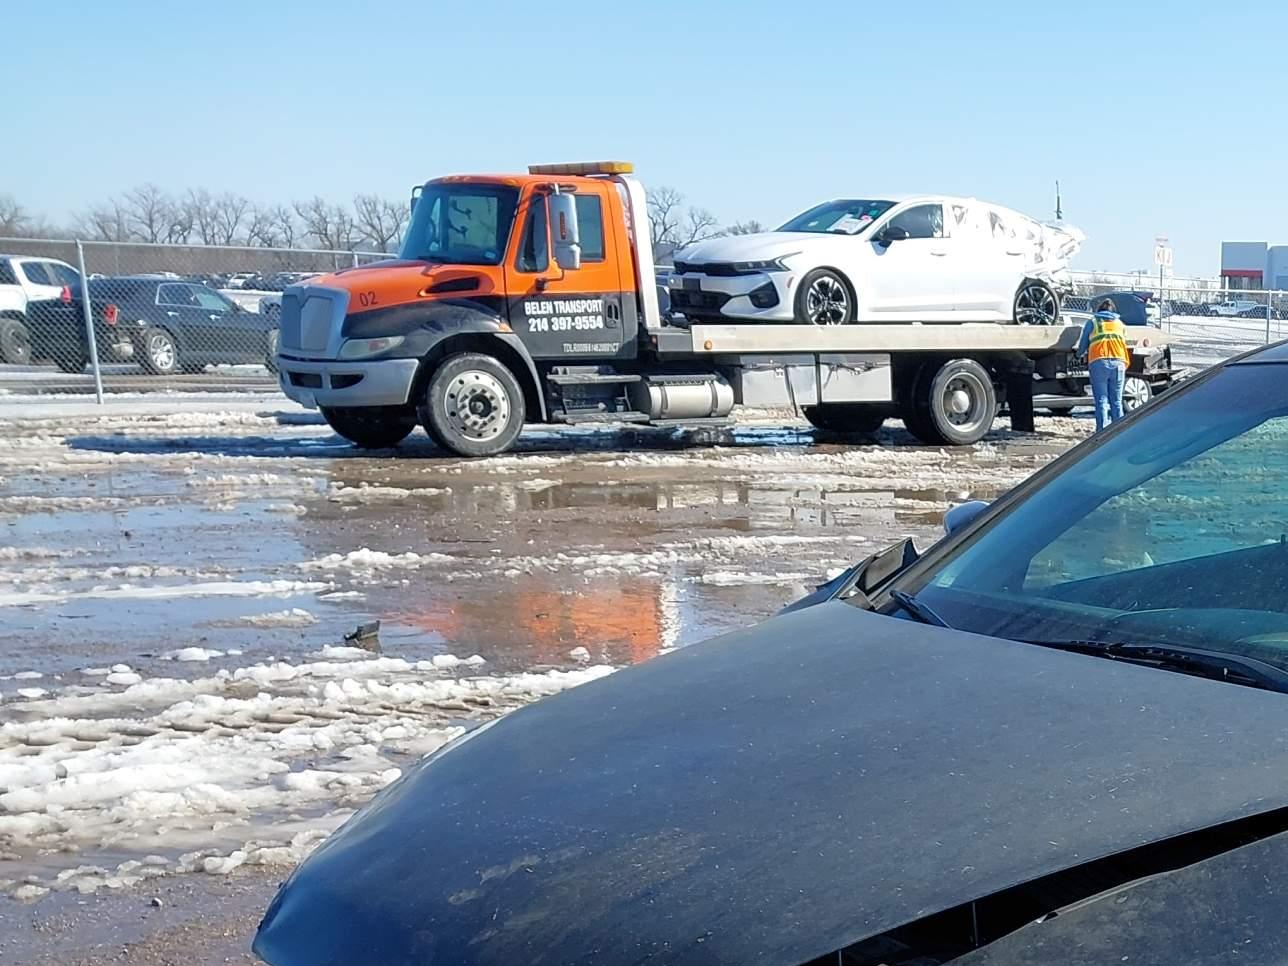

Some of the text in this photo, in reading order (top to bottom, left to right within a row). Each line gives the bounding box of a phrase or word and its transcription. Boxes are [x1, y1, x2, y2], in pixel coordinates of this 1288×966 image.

[359, 291, 378, 306] 02
[524, 299, 603, 315] BELEN TRANSPORT
[528, 315, 604, 332] 214 397-9554
